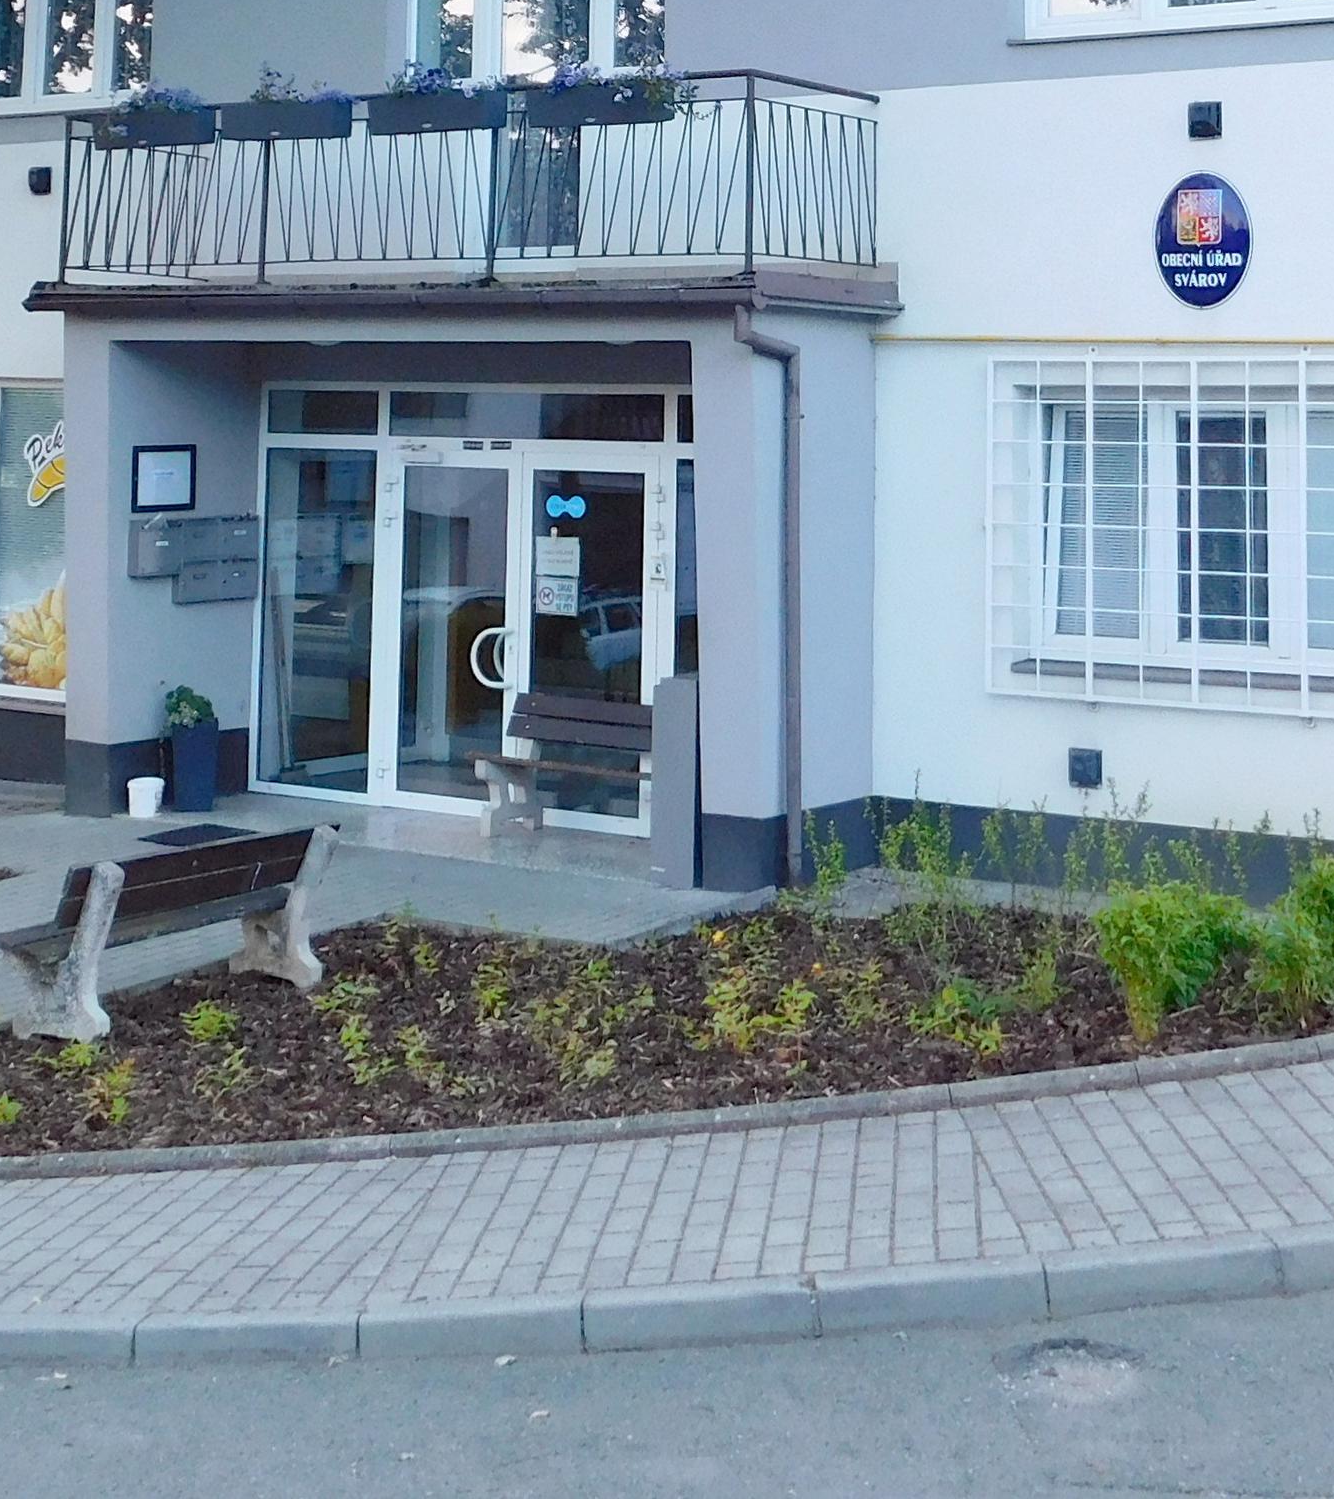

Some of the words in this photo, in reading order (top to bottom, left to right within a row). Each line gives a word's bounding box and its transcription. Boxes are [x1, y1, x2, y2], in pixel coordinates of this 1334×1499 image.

[1161, 249, 1203, 267] OBECNÍ
[1206, 249, 1243, 267] ÚŘAD
[1174, 269, 1227, 287] SVÁROV
